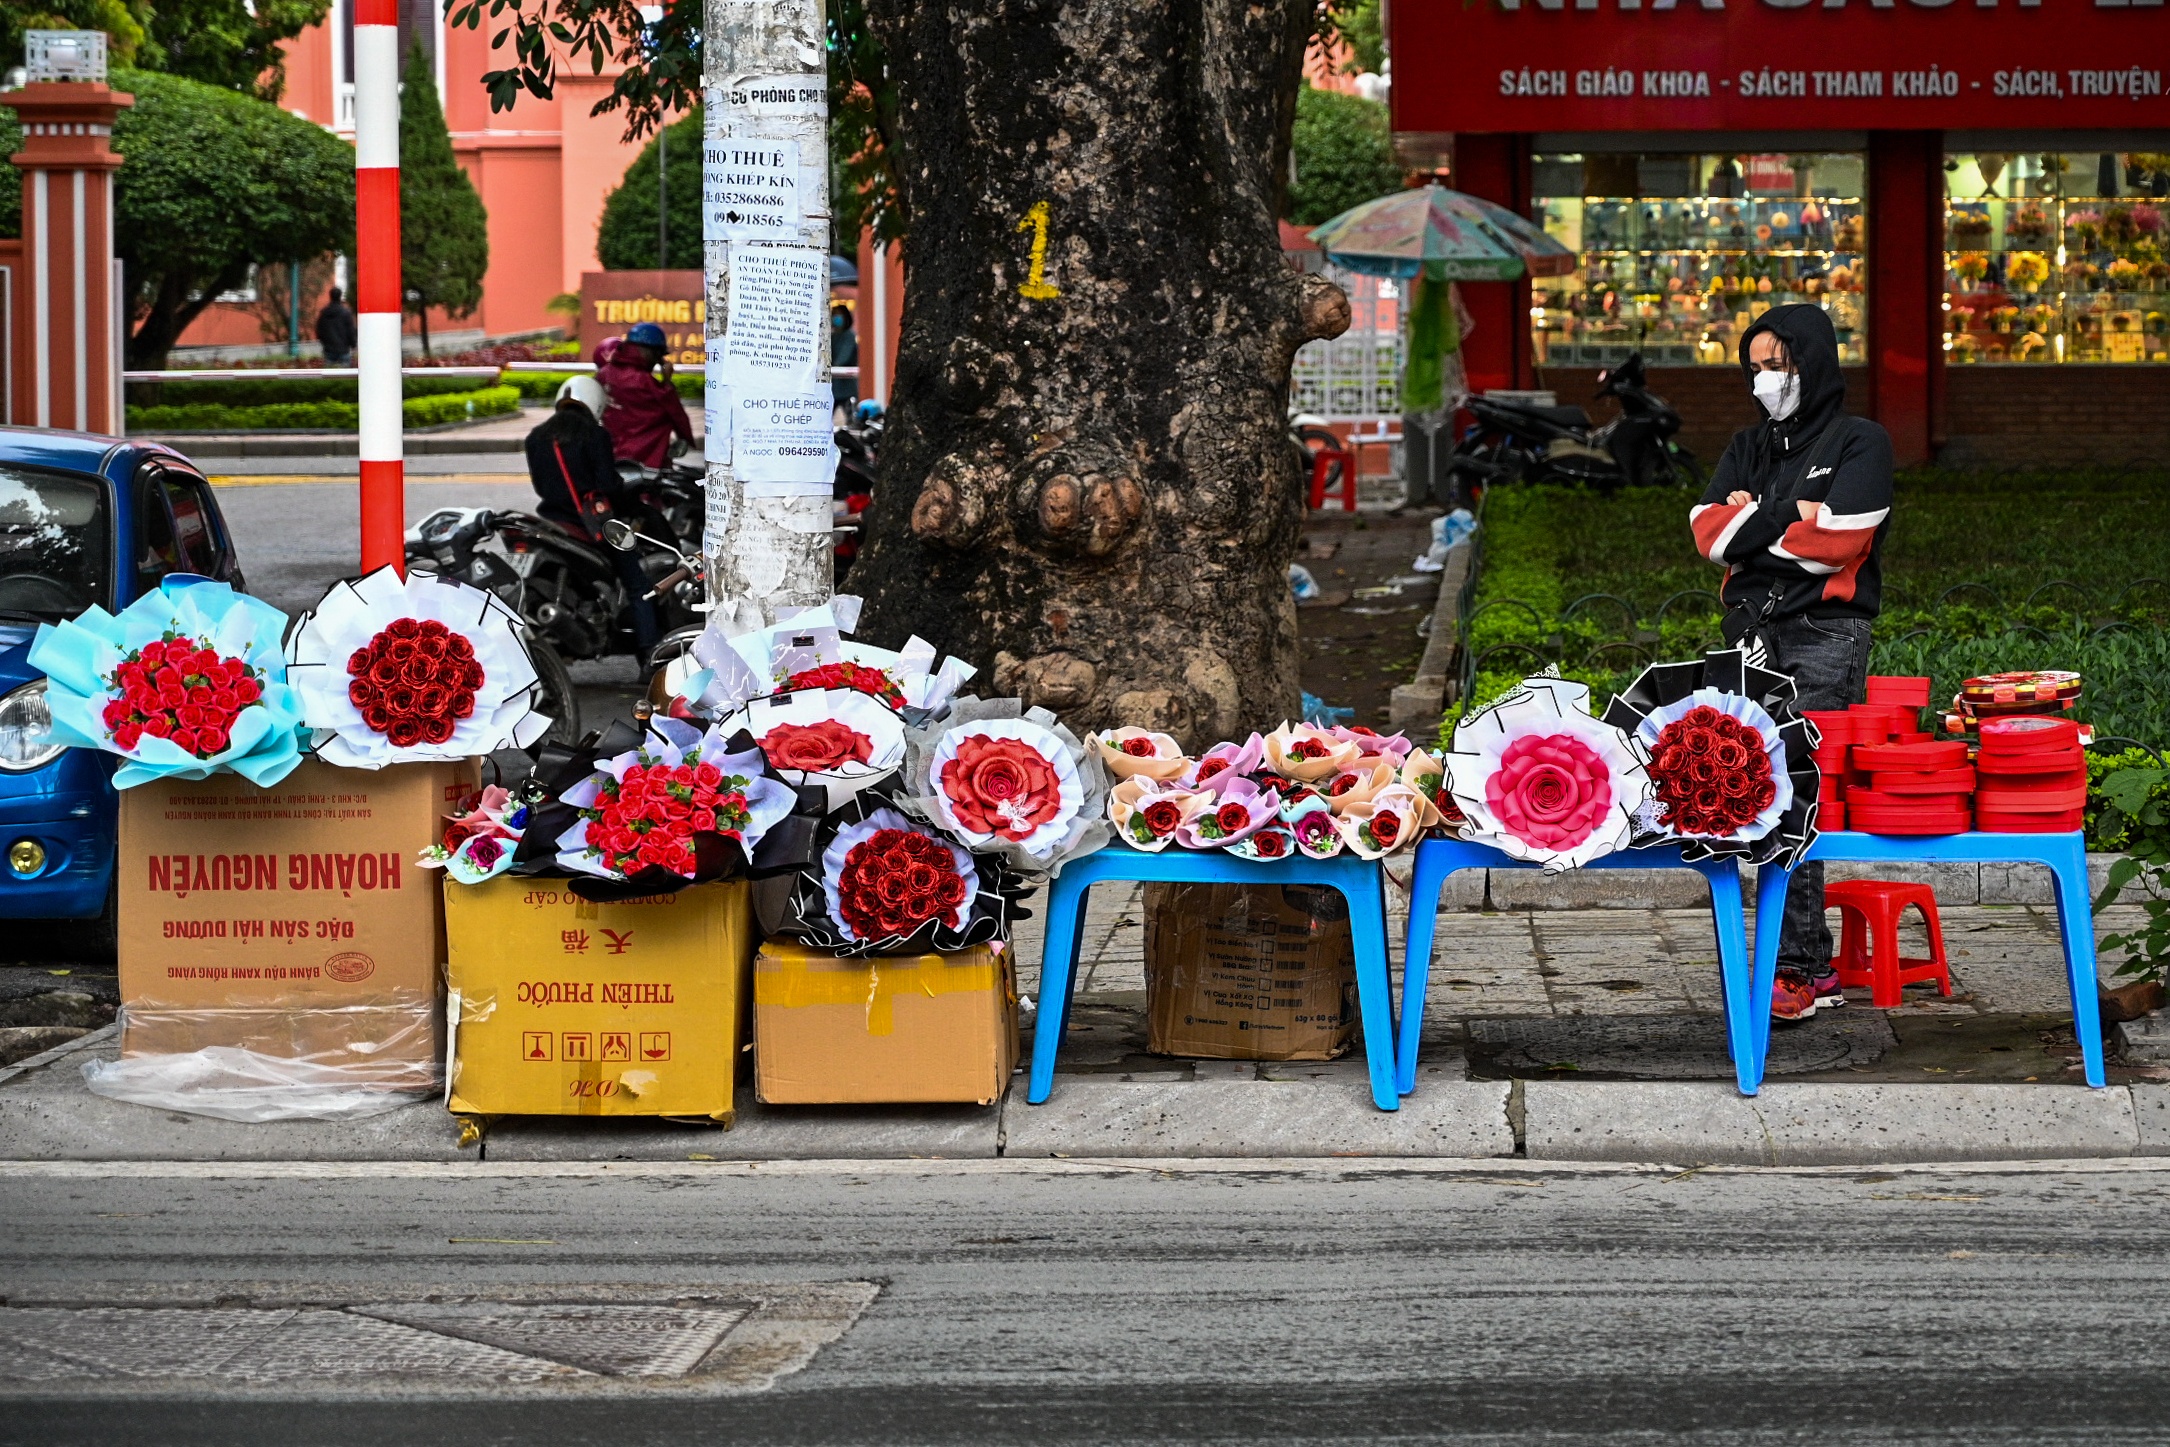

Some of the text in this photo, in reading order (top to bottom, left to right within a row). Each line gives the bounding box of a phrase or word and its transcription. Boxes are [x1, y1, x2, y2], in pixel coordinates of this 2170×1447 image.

[1500, 65, 1567, 96] SÁCH
[1575, 65, 1635, 96] GIÁO
[1643, 70, 1710, 96] KHOA
[1740, 65, 1806, 96] SÁCH
[1811, 70, 1883, 97] THAM
[1892, 63, 1959, 97] KHẢO
[1993, 65, 2064, 100] SÁCH,
[2068, 65, 2161, 101] TRUYỆN
[751, 85, 796, 103] PHÒNG
[799, 89, 818, 103] CHO
[704, 149, 785, 168] CHO THUÊ
[726, 171, 765, 186] KHÉP
[769, 173, 795, 188] KÍN
[714, 192, 784, 207] 0352868686
[714, 210, 784, 227] 091918565
[1016, 200, 1062, 302] 1
[738, 255, 818, 271] CHO THUÊ PHÒNG
[594, 294, 691, 324] TRƯỜNG
[743, 397, 830, 411] CHO THUÊ PHÒNG
[770, 412, 812, 425] Ở GHÉP
[272, 795, 282, 805] TP
[287, 794, 306, 806] CHÂU
[331, 794, 336, 804] 3
[338, 794, 352, 804] KHU
[193, 810, 216, 822] HOÀNG
[217, 810, 236, 820] XANH
[252, 810, 272, 821] BÁNH
[273, 809, 292, 820] TNHH
[293, 809, 301, 819] TY
[303, 808, 322, 820] CÔNG
[338, 808, 355, 823] XUẤT
[357, 808, 371, 820] SẢN
[149, 853, 401, 899] HOÀNG NGUYÊN
[523, 891, 558, 910] CẤP
[563, 891, 592, 905] AO
[163, 917, 354, 945] ĐẶC SẢN HẢI DƯƠNG
[561, 929, 634, 955] 天福
[167, 967, 197, 981] VÀNG
[198, 967, 229, 982] RỒNG
[231, 967, 261, 979] XANH
[264, 965, 287, 981] ĐẬU
[290, 966, 320, 981] BÁNH
[517, 981, 674, 1010] THIÊN PHƯỚC
